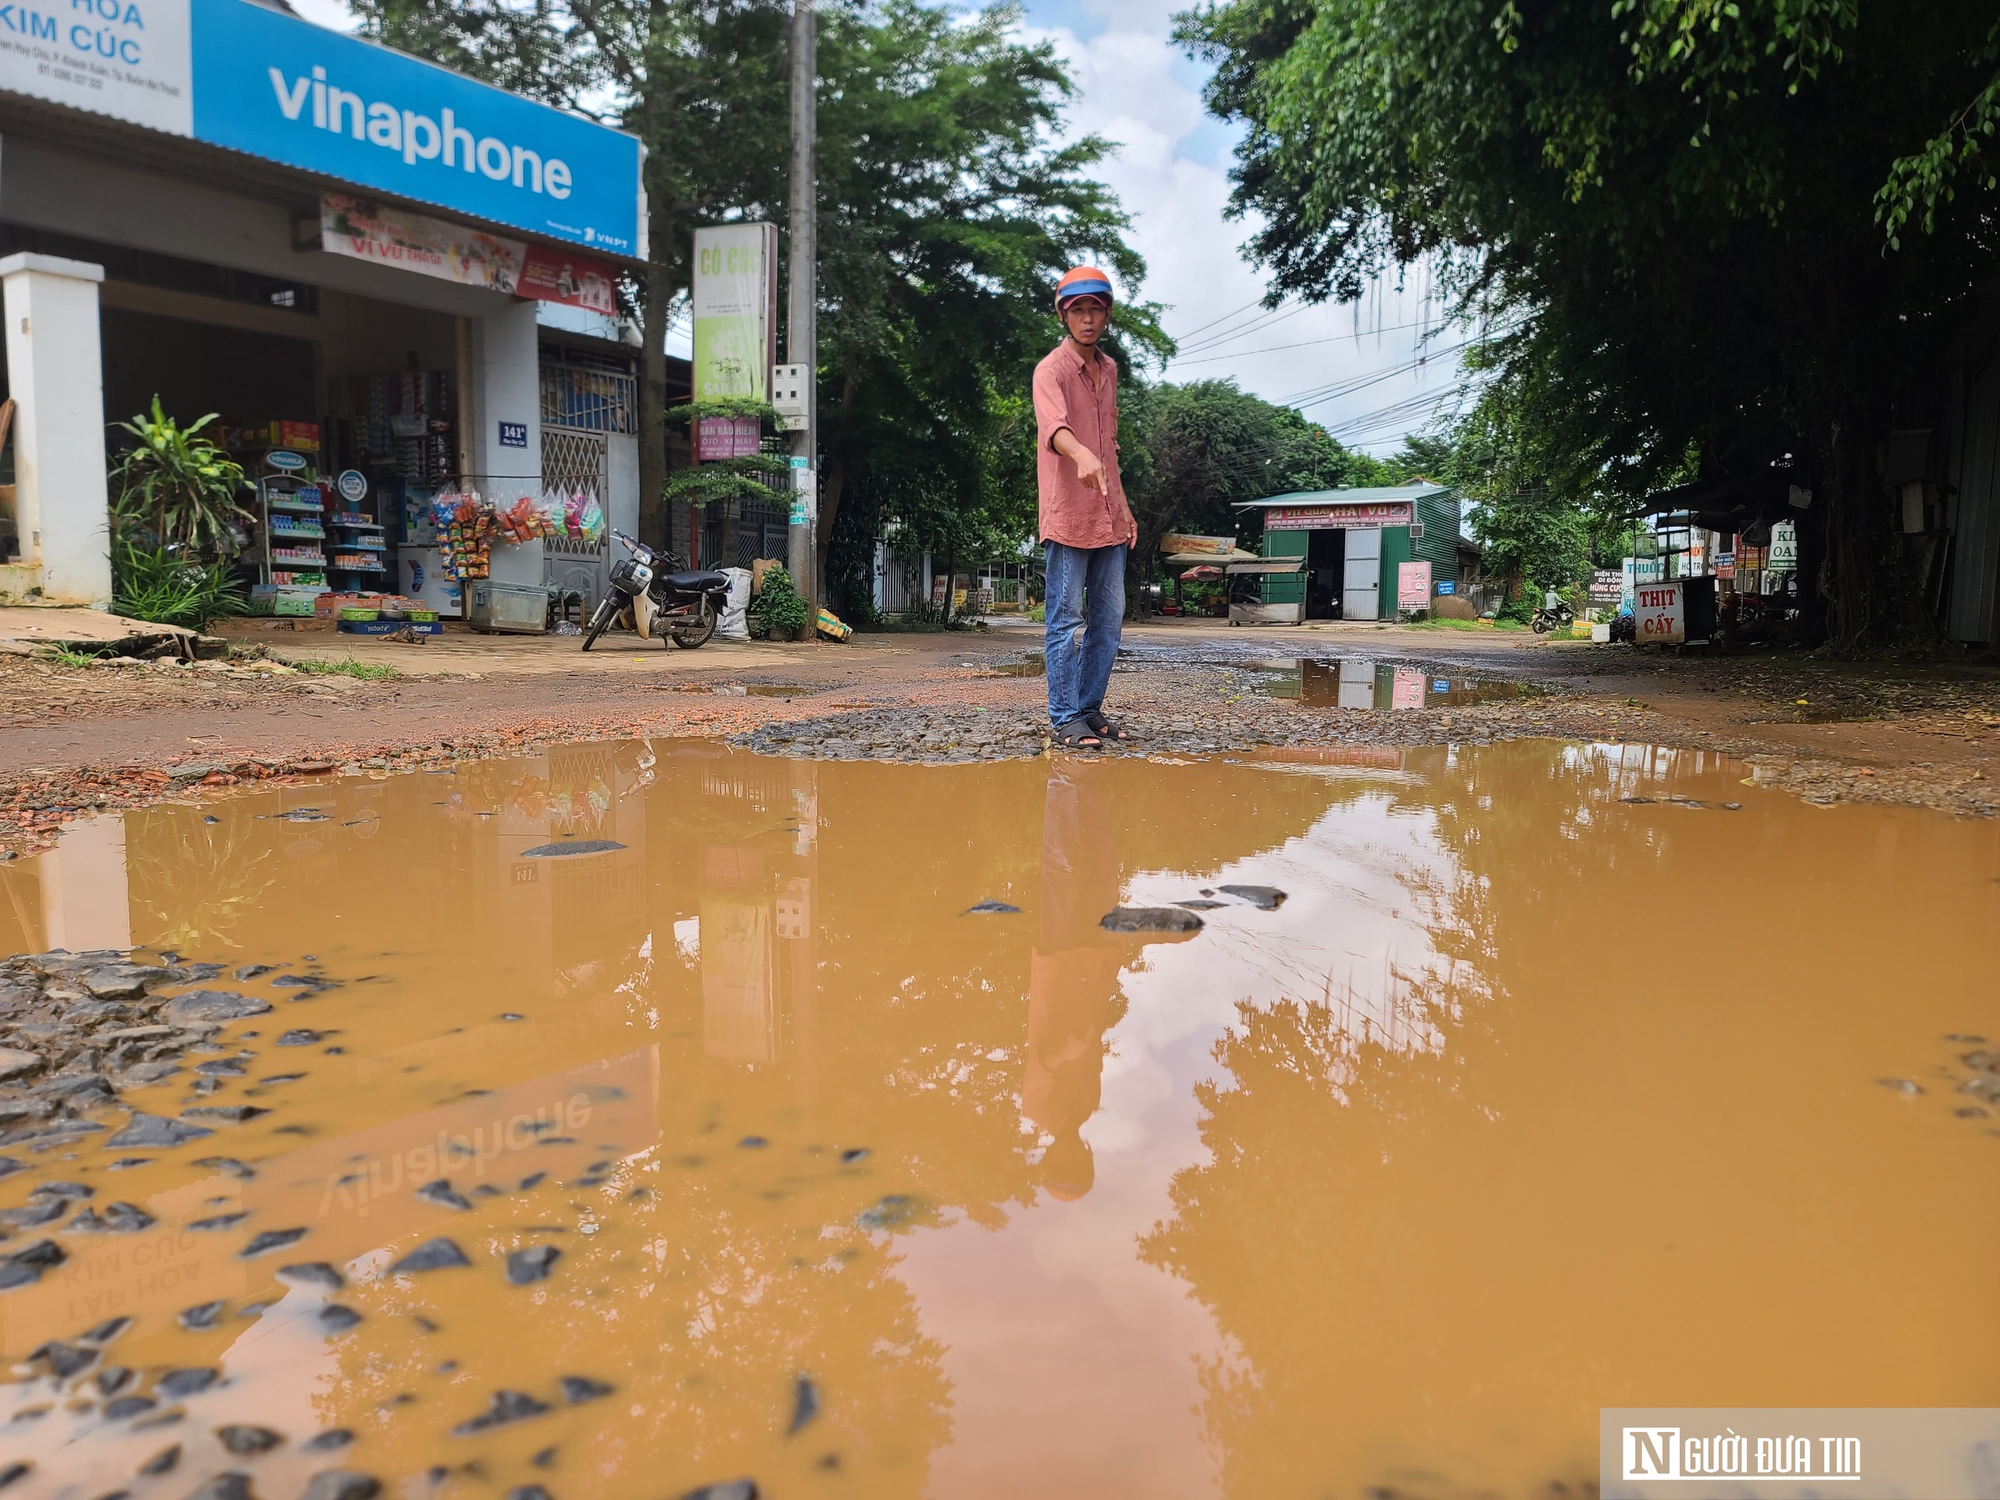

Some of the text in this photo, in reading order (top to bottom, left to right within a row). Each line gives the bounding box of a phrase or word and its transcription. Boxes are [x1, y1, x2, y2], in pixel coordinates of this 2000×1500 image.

[70, 27, 141, 66] CÚC
[268, 65, 572, 200] vinaphone
[597, 233, 628, 249] VNPT
[1777, 531, 1797, 541] KI
[1640, 589, 1676, 610] THỊT
[1644, 612, 1675, 635] CẦY
